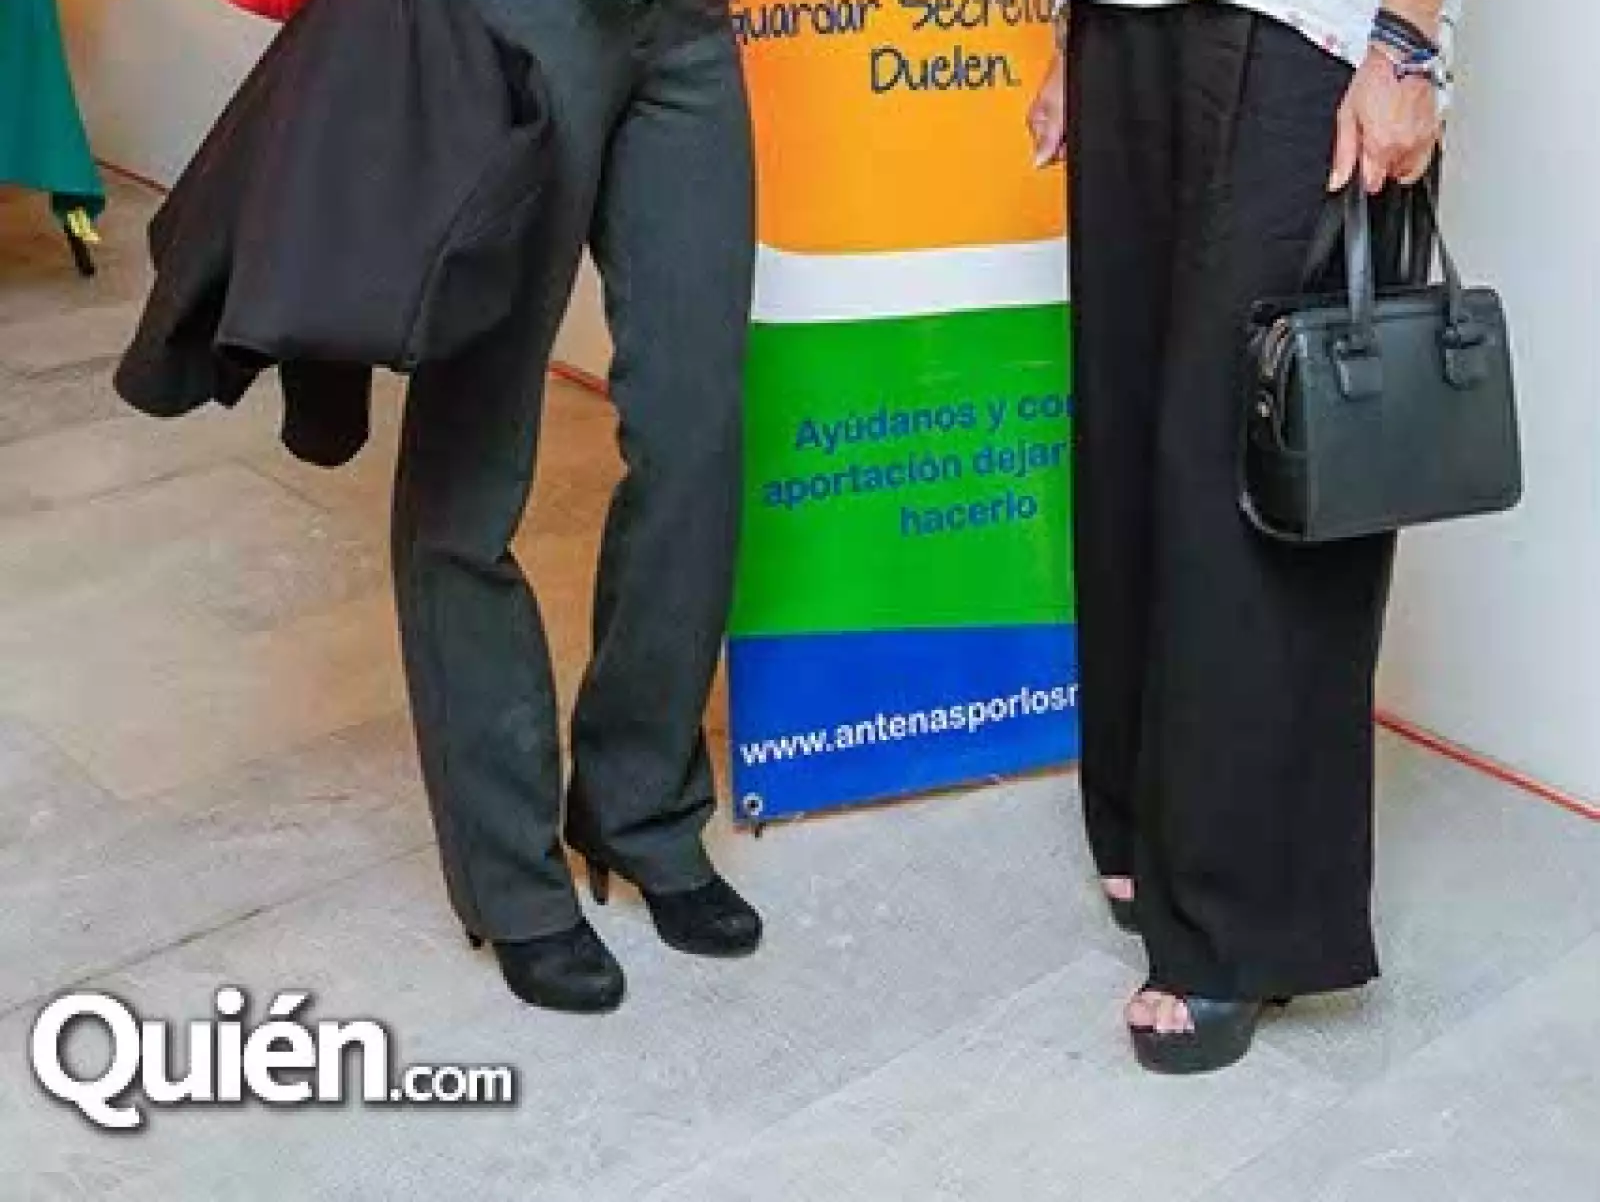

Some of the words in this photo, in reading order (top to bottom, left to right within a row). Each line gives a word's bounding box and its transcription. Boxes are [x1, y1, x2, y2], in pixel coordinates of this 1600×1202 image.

[986, 398, 1008, 431] y
[762, 451, 963, 509] aportación
[900, 491, 1037, 537] hacerlo
